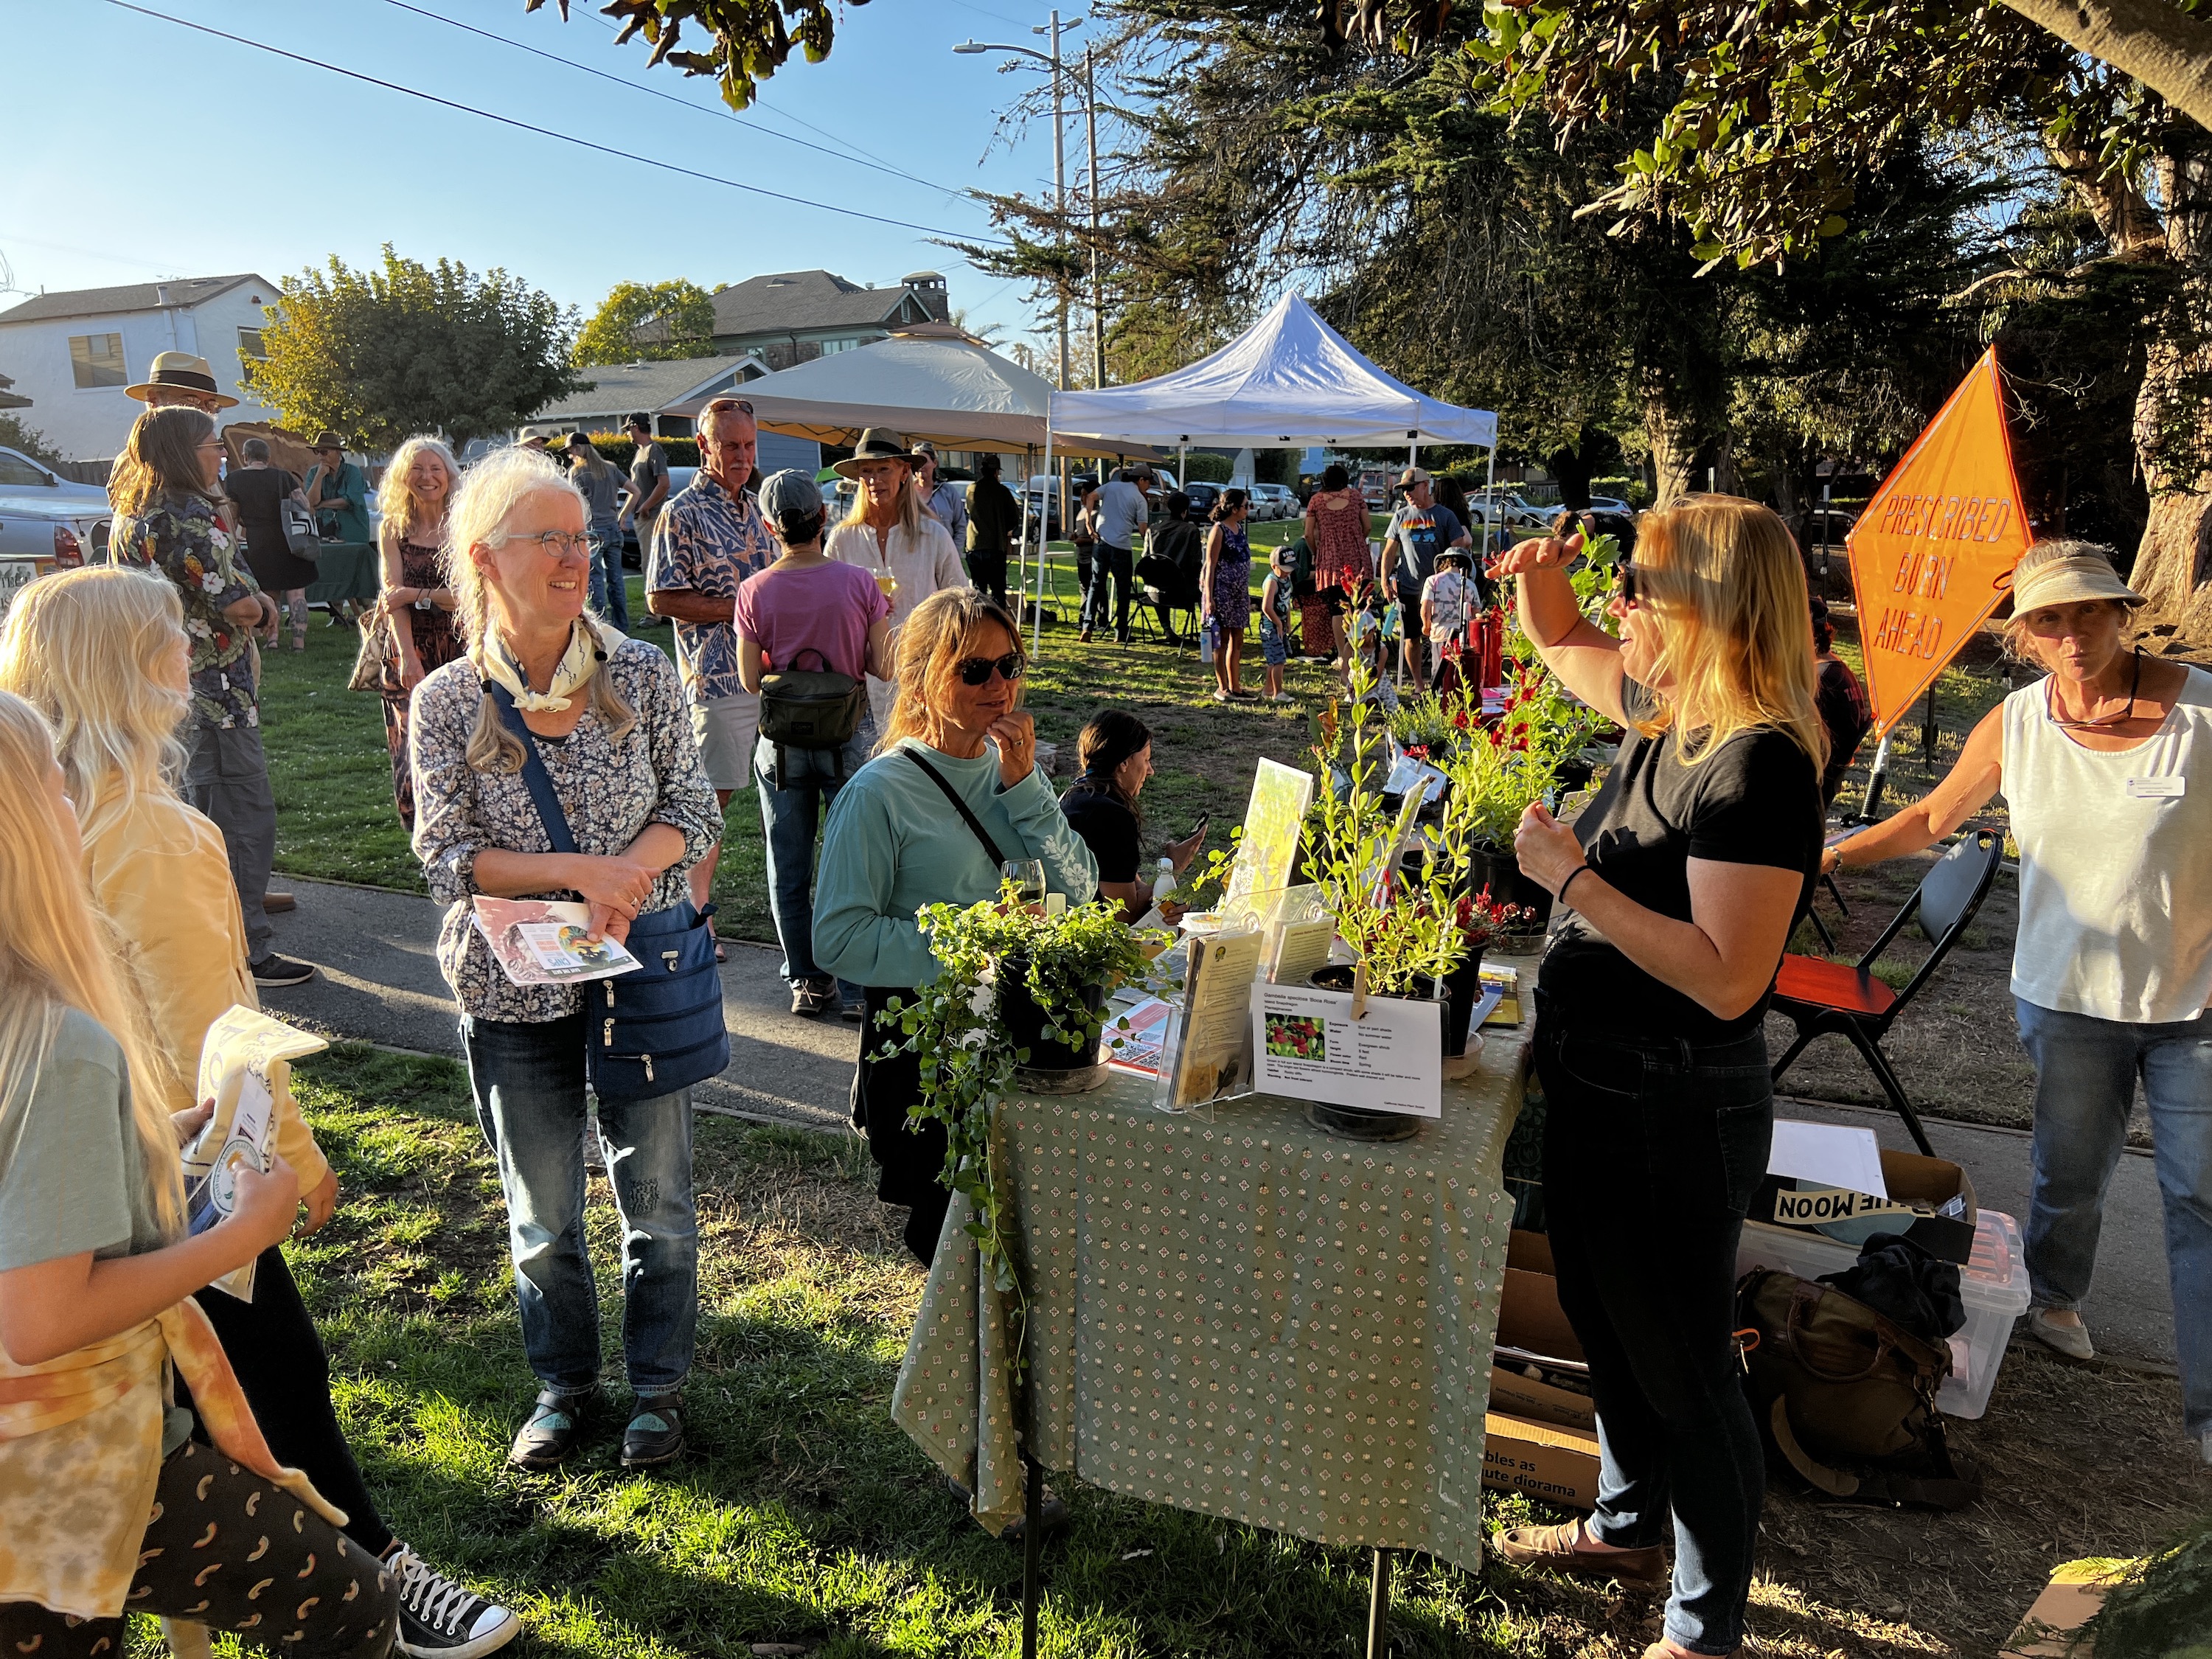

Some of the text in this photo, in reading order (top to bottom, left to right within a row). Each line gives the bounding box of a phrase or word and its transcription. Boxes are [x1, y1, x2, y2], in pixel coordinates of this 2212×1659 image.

[1880, 495, 2011, 543] PRESCRIBED
[1894, 552, 1954, 599] BURN
[1874, 608, 1942, 659] AHEAD
[548, 958, 571, 967] CNPS
[1779, 1193, 1854, 1219] MOON
[1520, 1460, 1536, 1472] as
[1514, 1474, 1576, 1498] diorama
